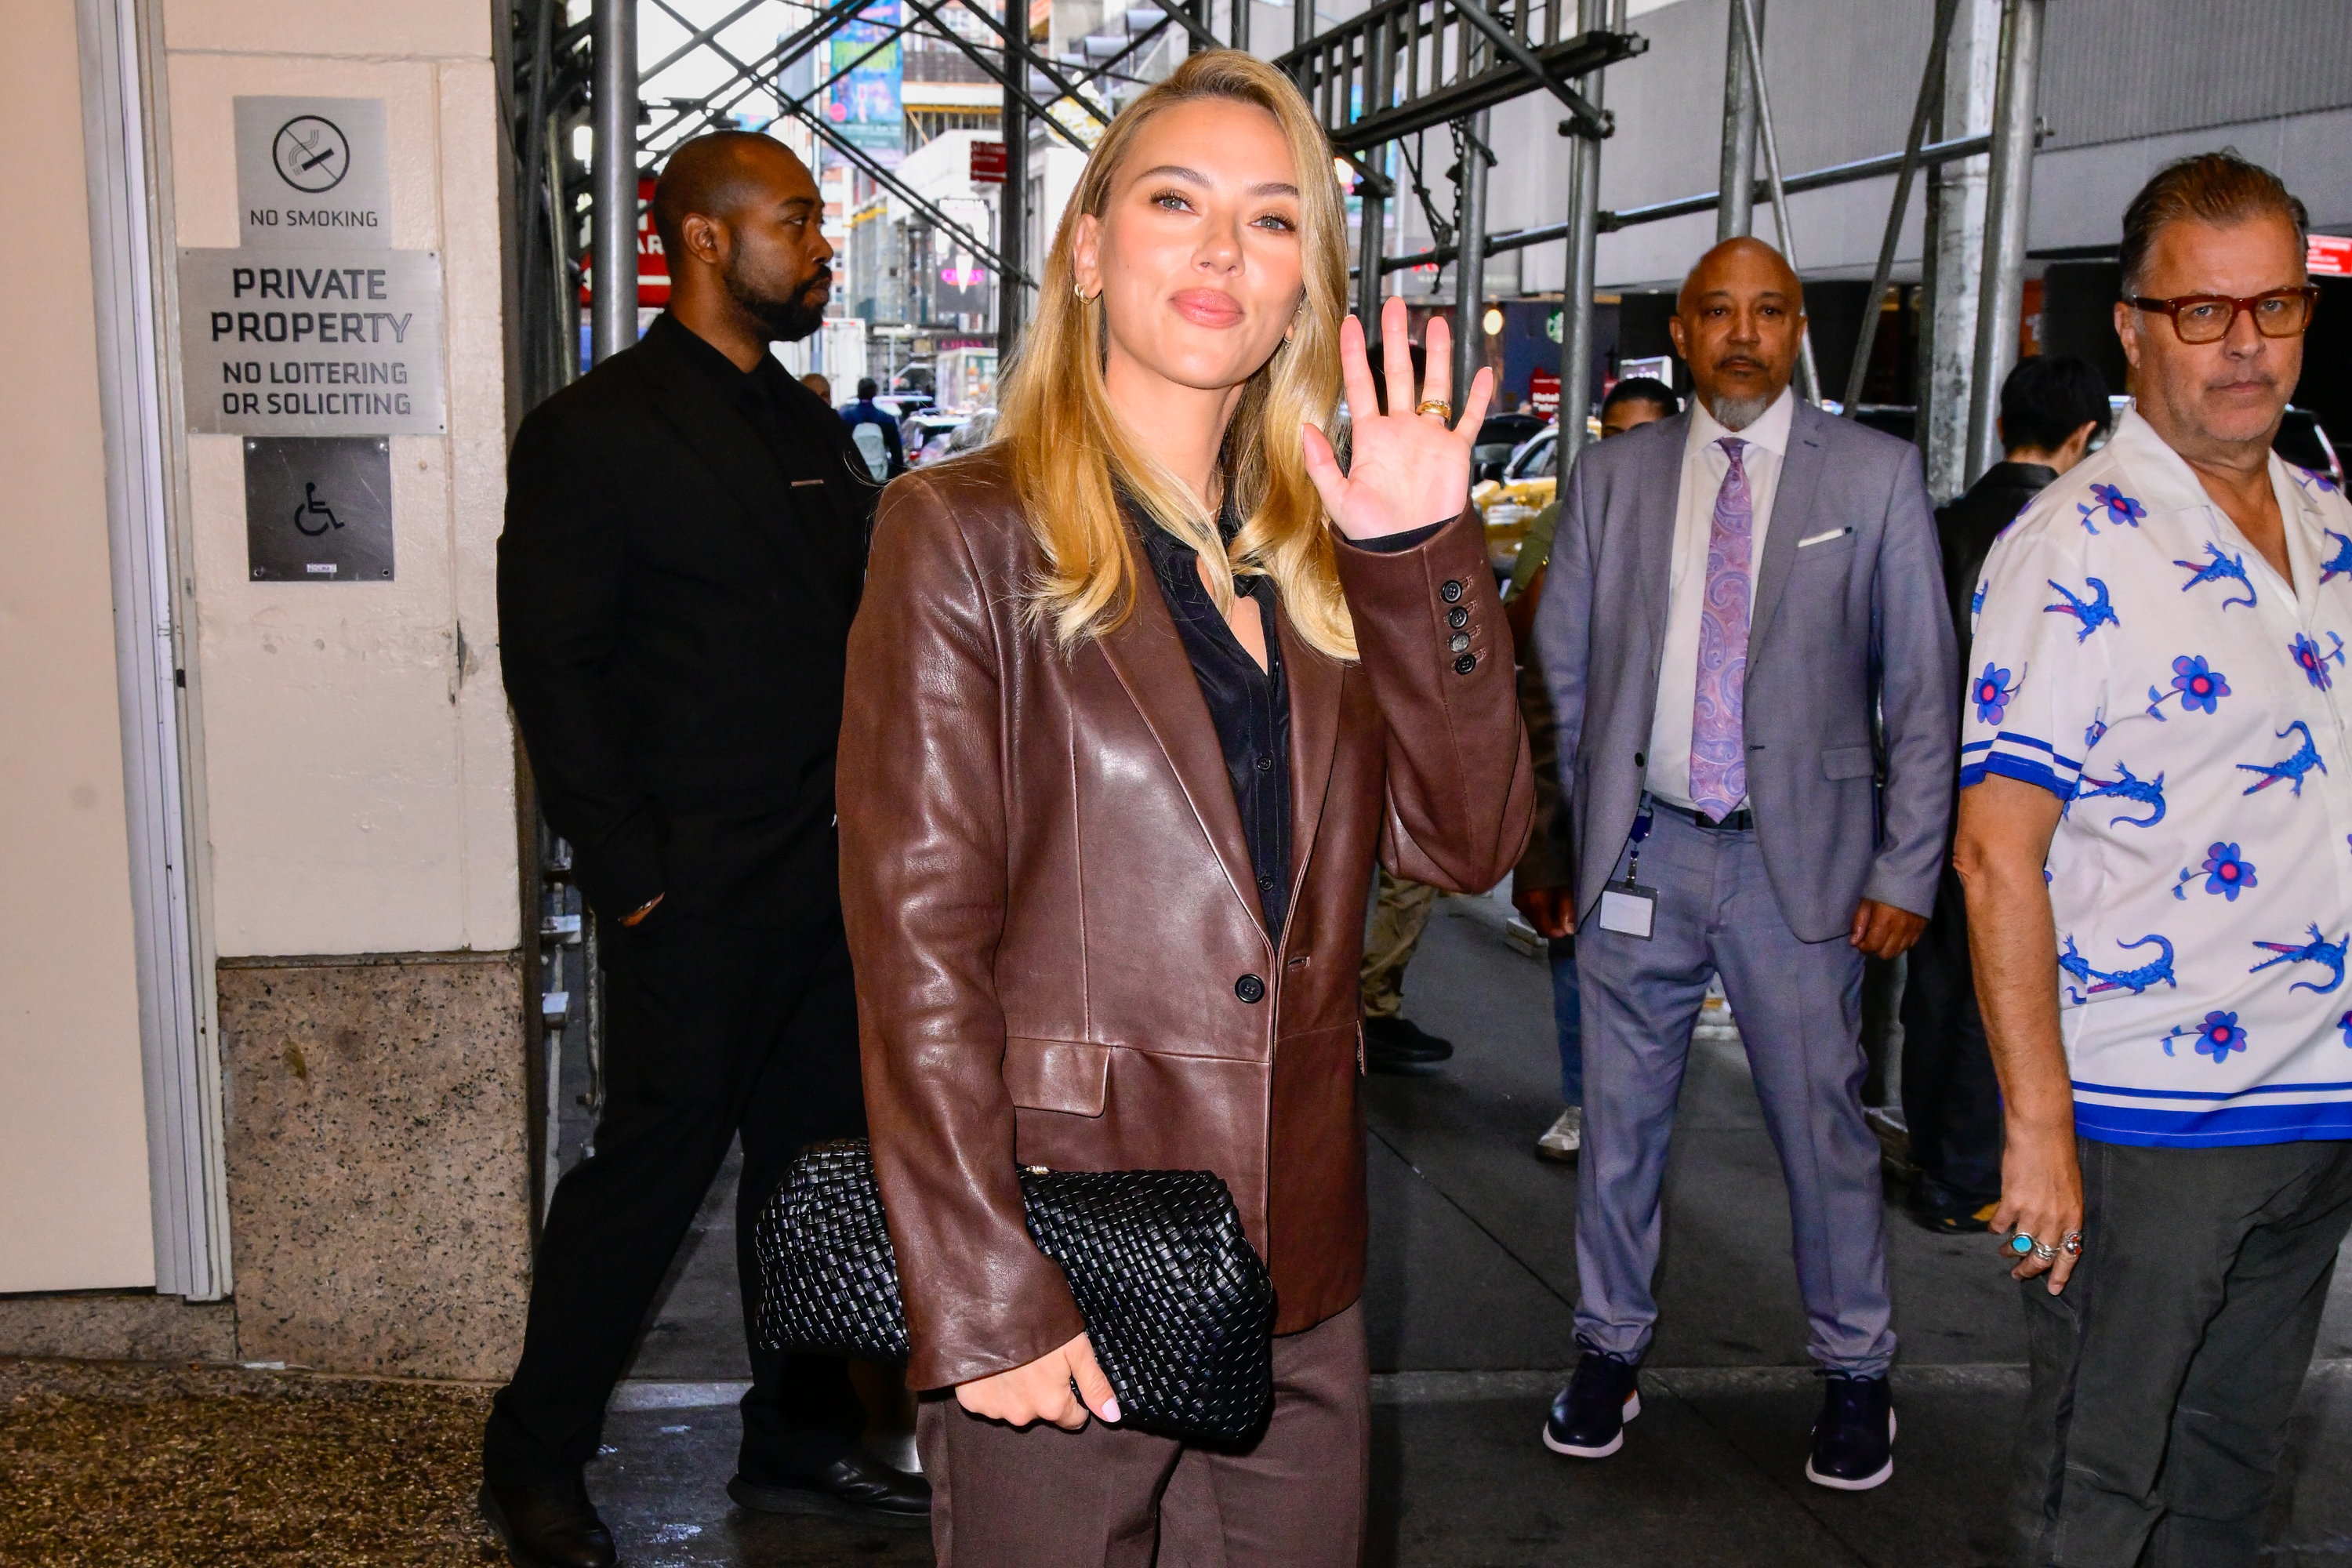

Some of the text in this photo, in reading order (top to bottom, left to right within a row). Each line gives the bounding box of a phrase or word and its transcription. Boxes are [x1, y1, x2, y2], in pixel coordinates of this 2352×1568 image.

[250, 209, 378, 227] NO SMOKING
[233, 268, 387, 299] PRIVATE
[211, 312, 412, 343] PROPERTY
[223, 361, 407, 384] NO LOITERING
[223, 393, 411, 415] OR SOLICITING
